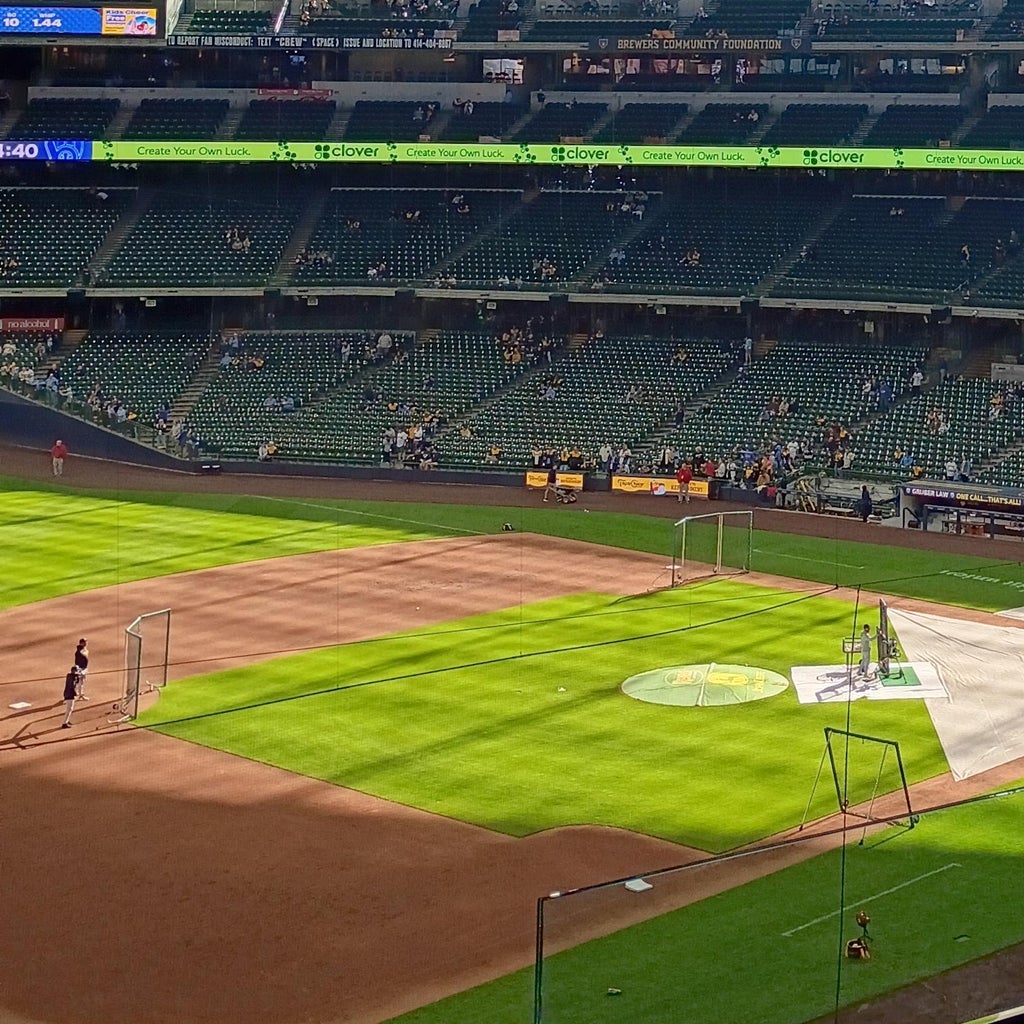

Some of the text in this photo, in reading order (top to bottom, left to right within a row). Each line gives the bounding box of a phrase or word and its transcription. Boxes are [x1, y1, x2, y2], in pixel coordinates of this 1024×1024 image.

[3, 18, 62, 27] 10 1.44
[258, 37, 272, 46] TEXT
[343, 38, 361, 48] ISSUE
[362, 38, 374, 48] AND
[376, 38, 403, 48] LOCATION
[617, 39, 782, 50] BREWERS COMMUNITY FOUNDATION
[137, 146, 251, 156] Create Your Own Luck.
[332, 144, 379, 157] clover
[406, 148, 504, 158] Create Your Own Luck.
[566, 146, 609, 160] clover
[642, 151, 745, 161] Create Your Own Luck.
[819, 150, 864, 163] clover
[926, 154, 1024, 165] Create Your Own Luck.
[20, 319, 50, 328] alcohol
[912, 488, 948, 498] GRUBER LAW
[956, 493, 969, 501] ONE
